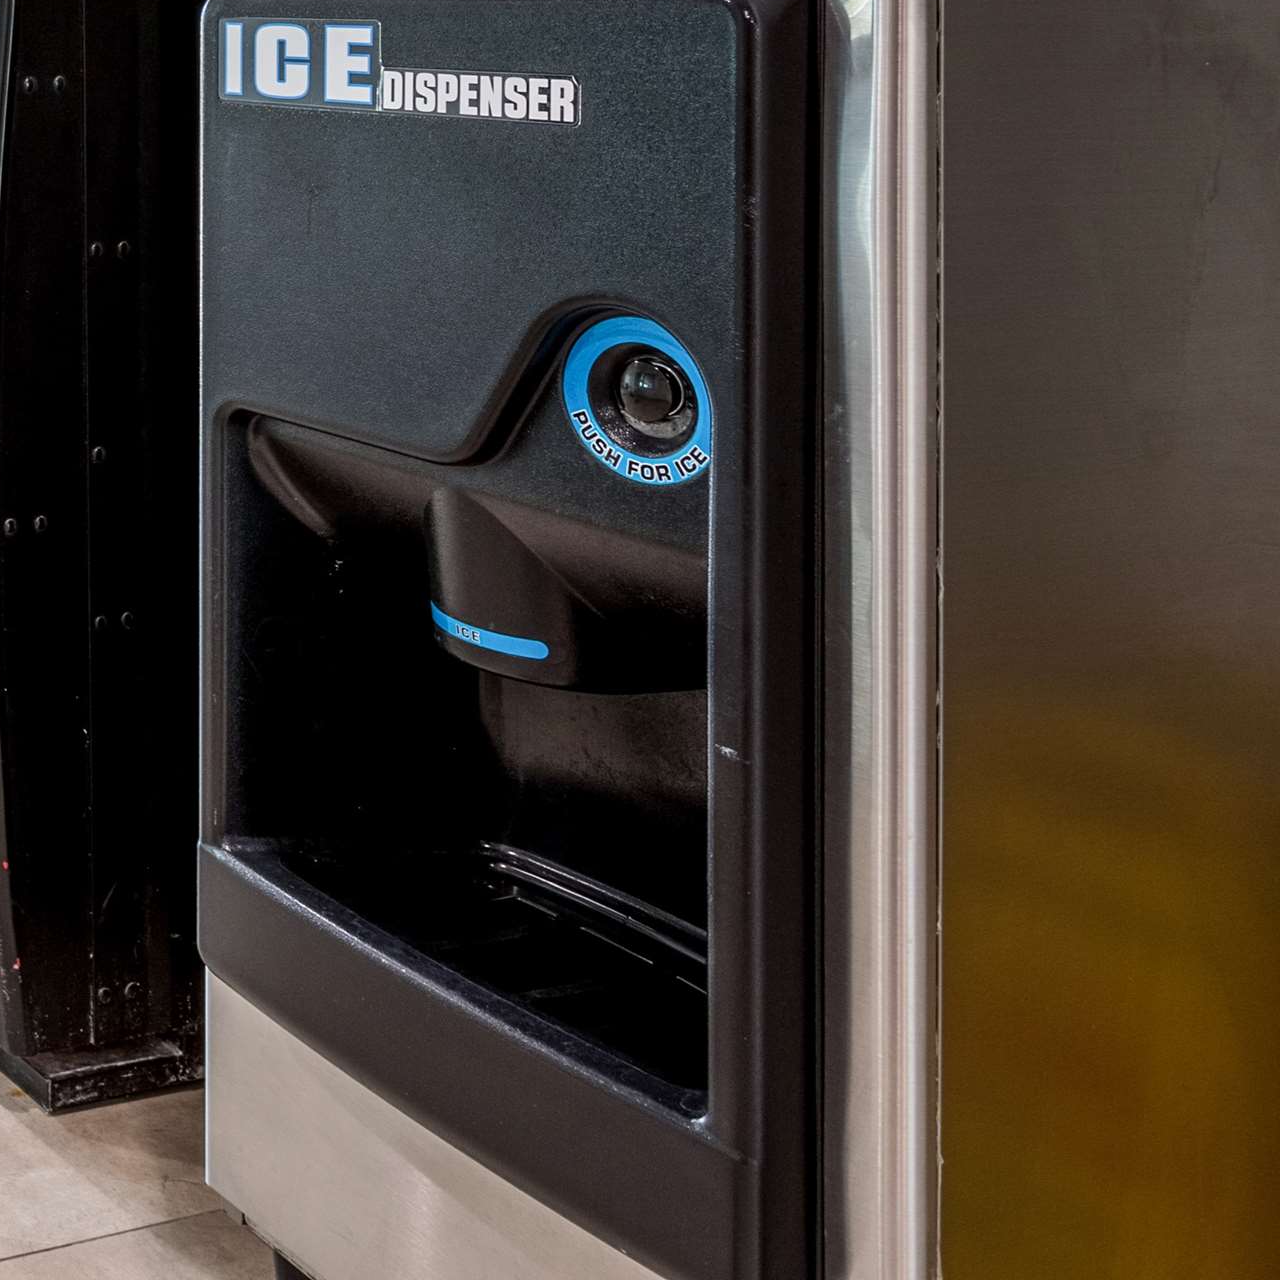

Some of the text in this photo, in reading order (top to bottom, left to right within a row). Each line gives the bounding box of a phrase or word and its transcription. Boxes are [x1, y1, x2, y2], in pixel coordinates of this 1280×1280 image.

[223, 21, 576, 123] ICE DISPENSER
[572, 410, 709, 481] PUSH FOR ICE
[455, 623, 480, 641] ICE
